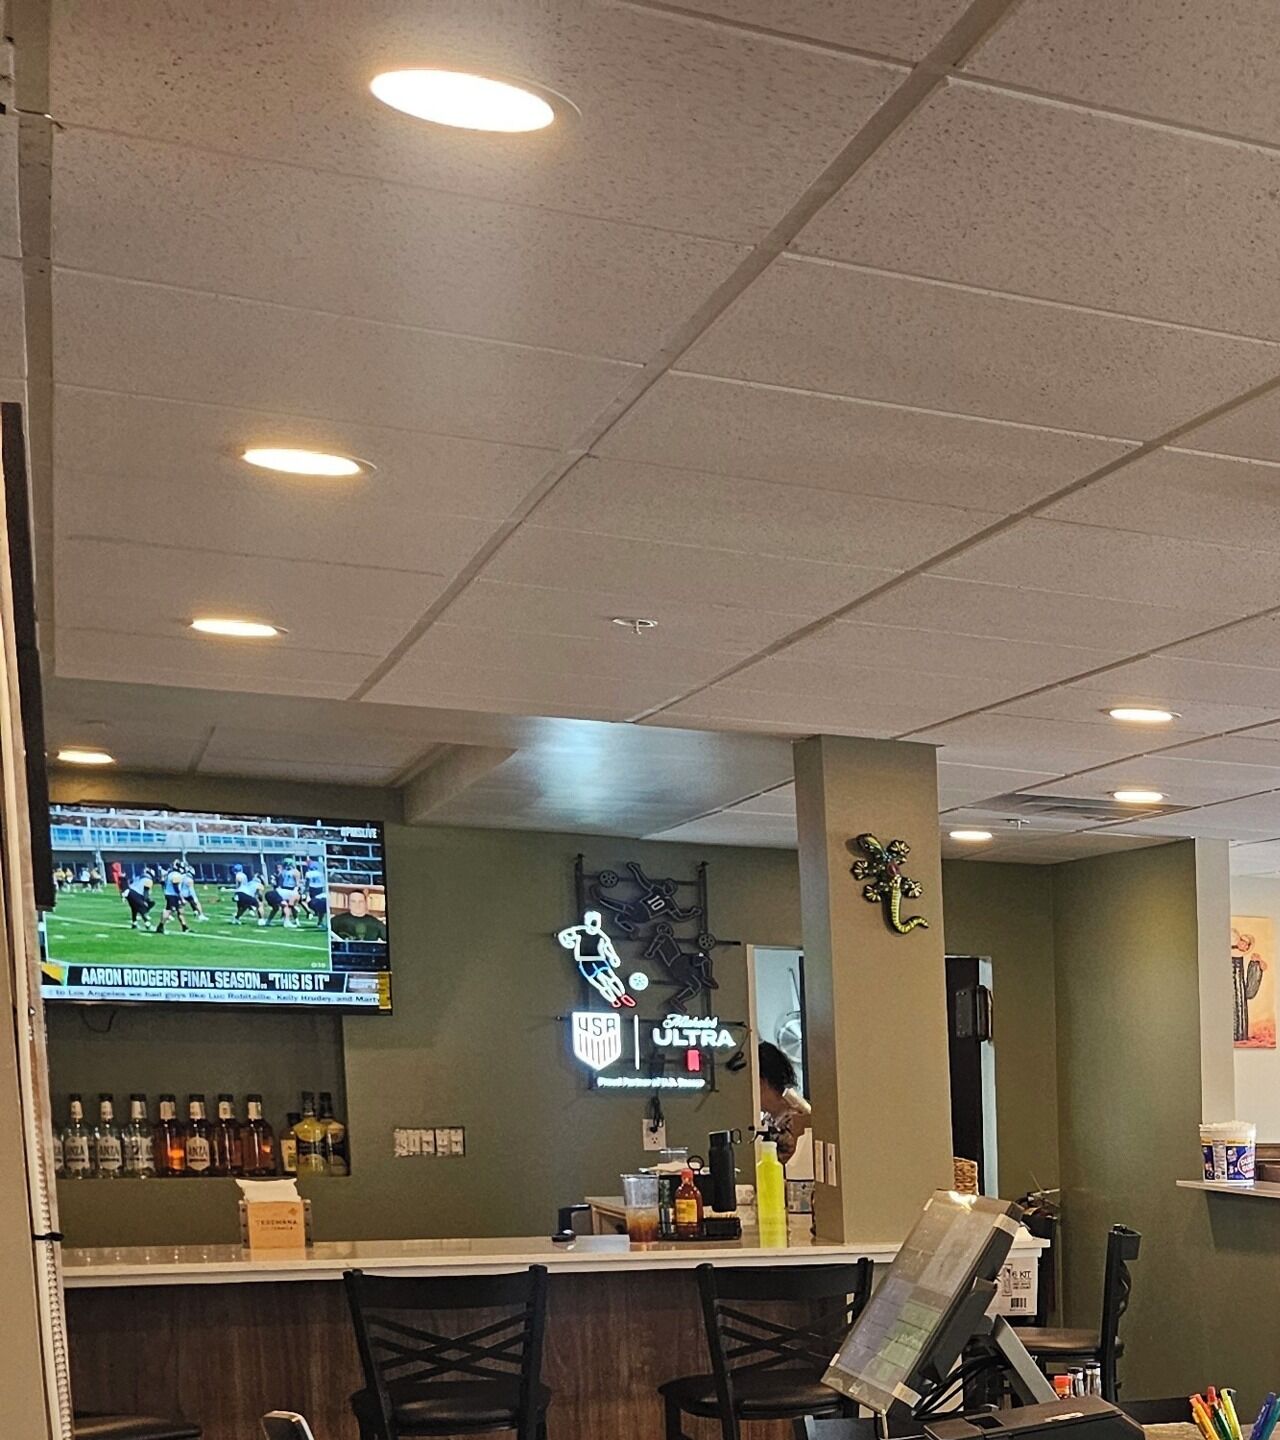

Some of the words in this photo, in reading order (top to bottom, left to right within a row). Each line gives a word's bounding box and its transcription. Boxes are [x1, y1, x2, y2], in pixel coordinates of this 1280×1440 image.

[647, 895, 665, 910] 10
[81, 967, 122, 986] AARON
[123, 969, 180, 988] RODGERS
[180, 970, 215, 989] FINAL
[268, 973, 300, 990] "THIS
[301, 974, 313, 991] IS
[314, 974, 330, 991] IT"
[578, 1017, 616, 1037] USA
[652, 1027, 737, 1047] ULTRA
